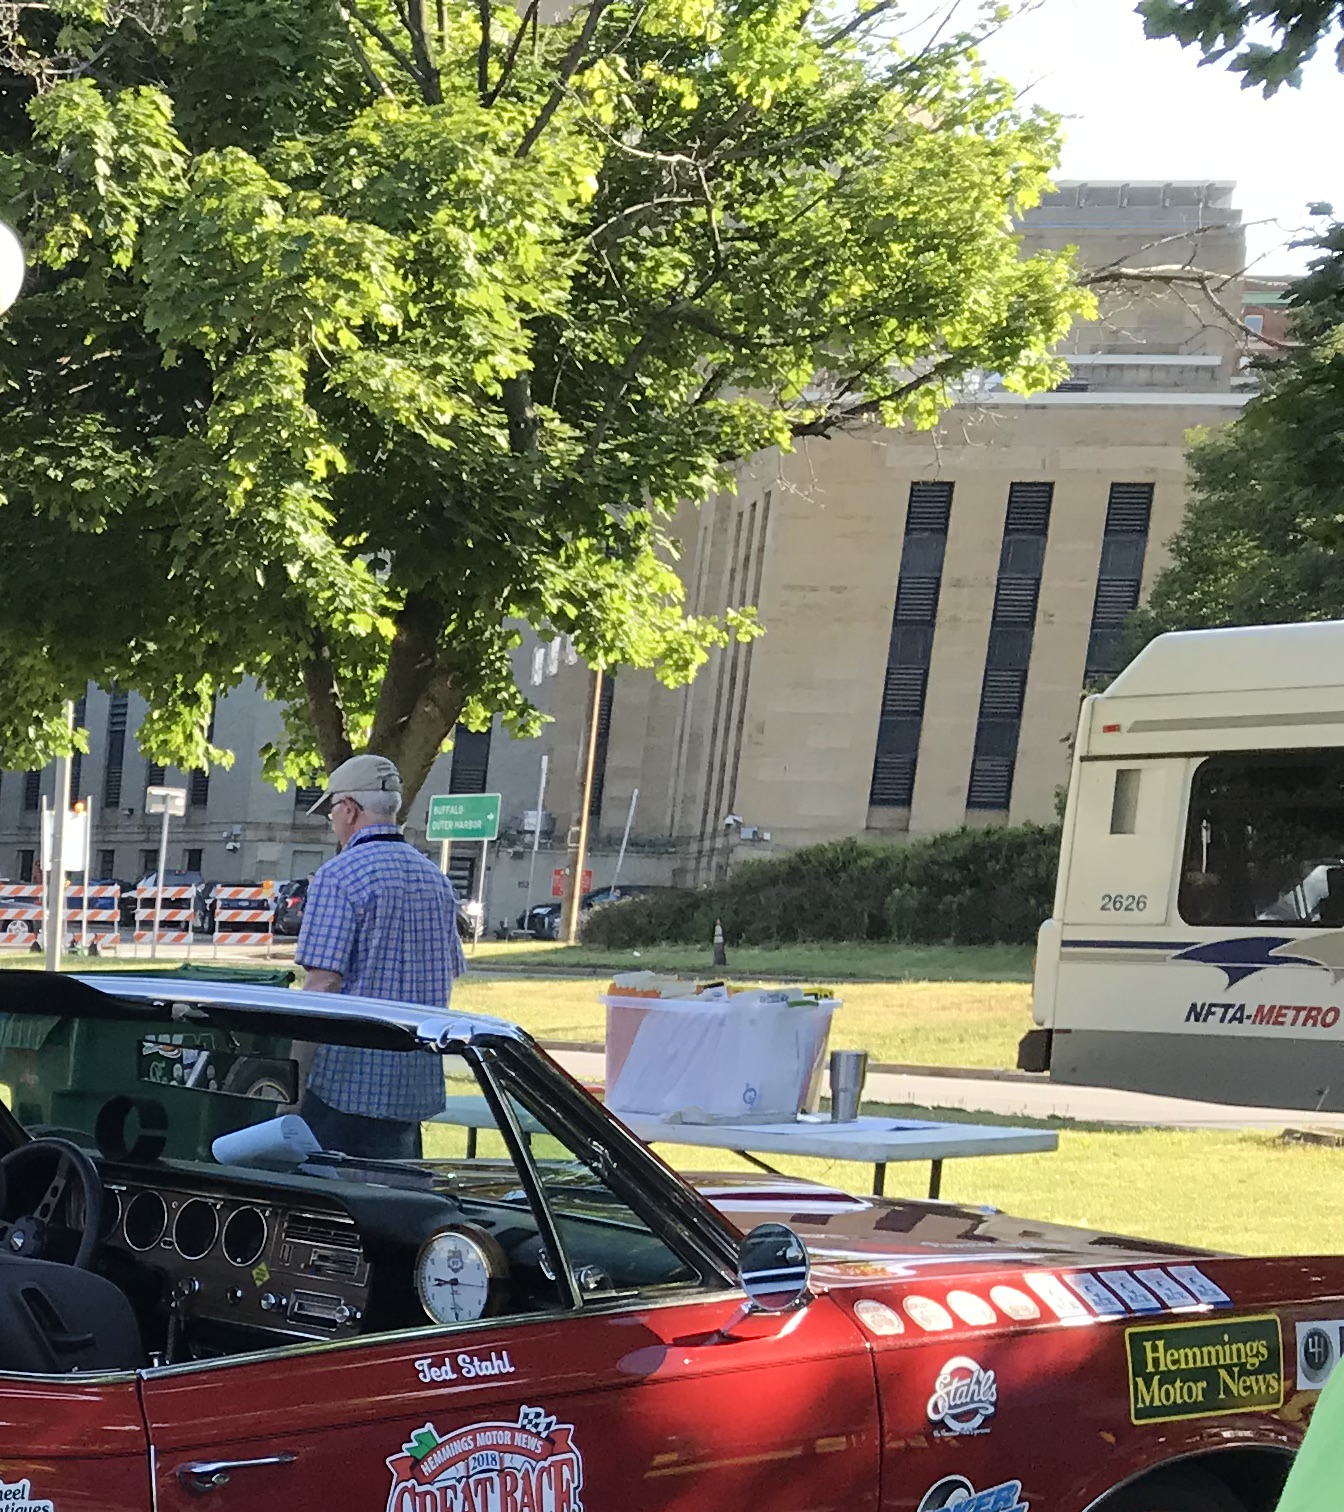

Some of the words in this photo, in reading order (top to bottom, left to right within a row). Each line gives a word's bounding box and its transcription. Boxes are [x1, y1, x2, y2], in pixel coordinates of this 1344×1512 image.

[433, 805, 464, 815] BUFFALO
[432, 821, 453, 831] OUTER
[455, 820, 483, 830] HARBOR
[1100, 894, 1147, 912] 2626
[1184, 1002, 1340, 1029] NFTA-METRO
[414, 1357, 457, 1383] Ted
[457, 1350, 515, 1378] Stahl
[1143, 1333, 1268, 1373] Hemmings
[1136, 1375, 1207, 1408] Motor
[1218, 1367, 1279, 1399] News
[420, 1434, 474, 1477] HEMMINGS
[475, 1431, 512, 1447] MOTOR
[514, 1432, 544, 1454] NEWS
[471, 1454, 498, 1471] 2018
